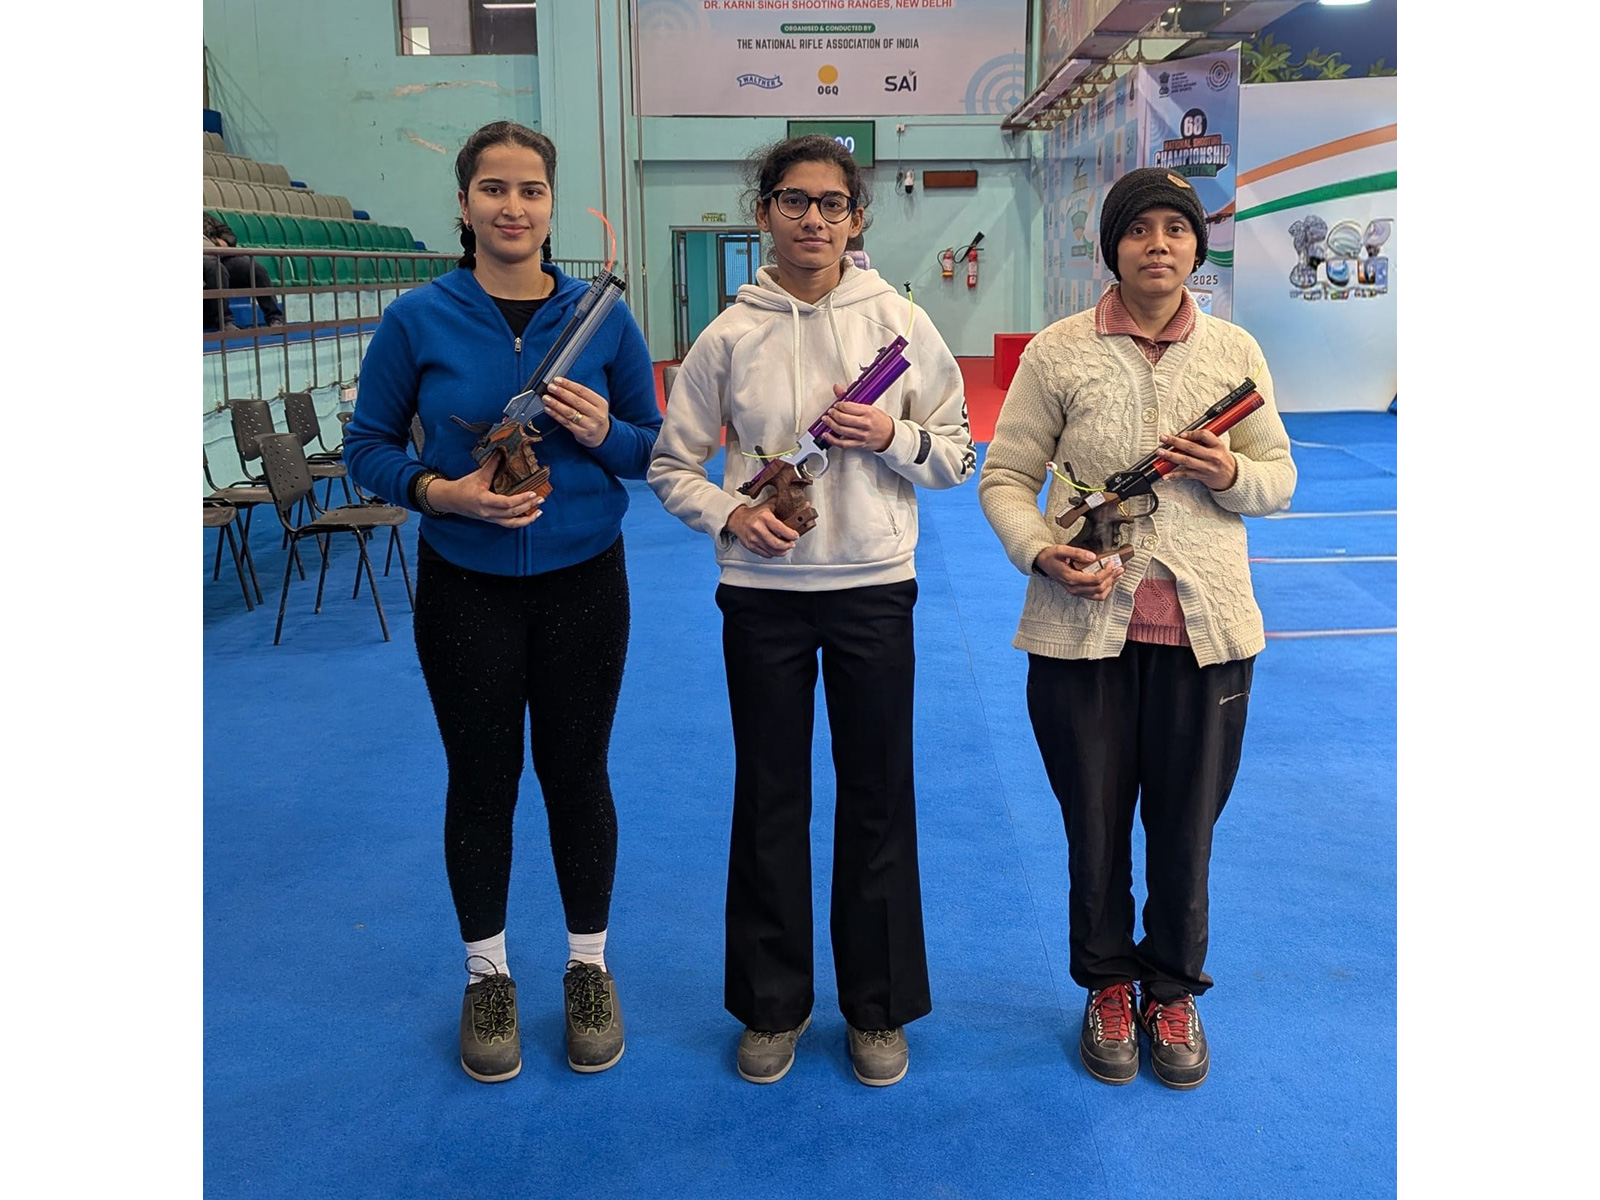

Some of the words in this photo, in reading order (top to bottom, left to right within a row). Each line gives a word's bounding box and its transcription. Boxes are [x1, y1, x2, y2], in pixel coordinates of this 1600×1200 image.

[704, 0, 720, 9] DR.
[724, 0, 755, 9] KARNI
[757, 0, 789, 9] SINGH
[792, 0, 844, 9] SHOOTING
[848, 0, 893, 9] RANGES,
[896, 0, 919, 8] NEW
[922, 0, 952, 8] DELHI
[737, 39, 753, 49] THE
[755, 39, 797, 49] NATIONAL
[800, 39, 823, 49] RIFLE
[826, 38, 881, 49] ASSOCIATION
[883, 38, 894, 49] OF
[896, 38, 919, 49] INDIA
[742, 75, 777, 88] WALTHER
[884, 74, 917, 92] SAI
[817, 86, 839, 95] OGQ
[1183, 115, 1203, 137] 68
[1154, 144, 1231, 168] CHAMPIONSHIP
[1193, 275, 1219, 285] 2025
